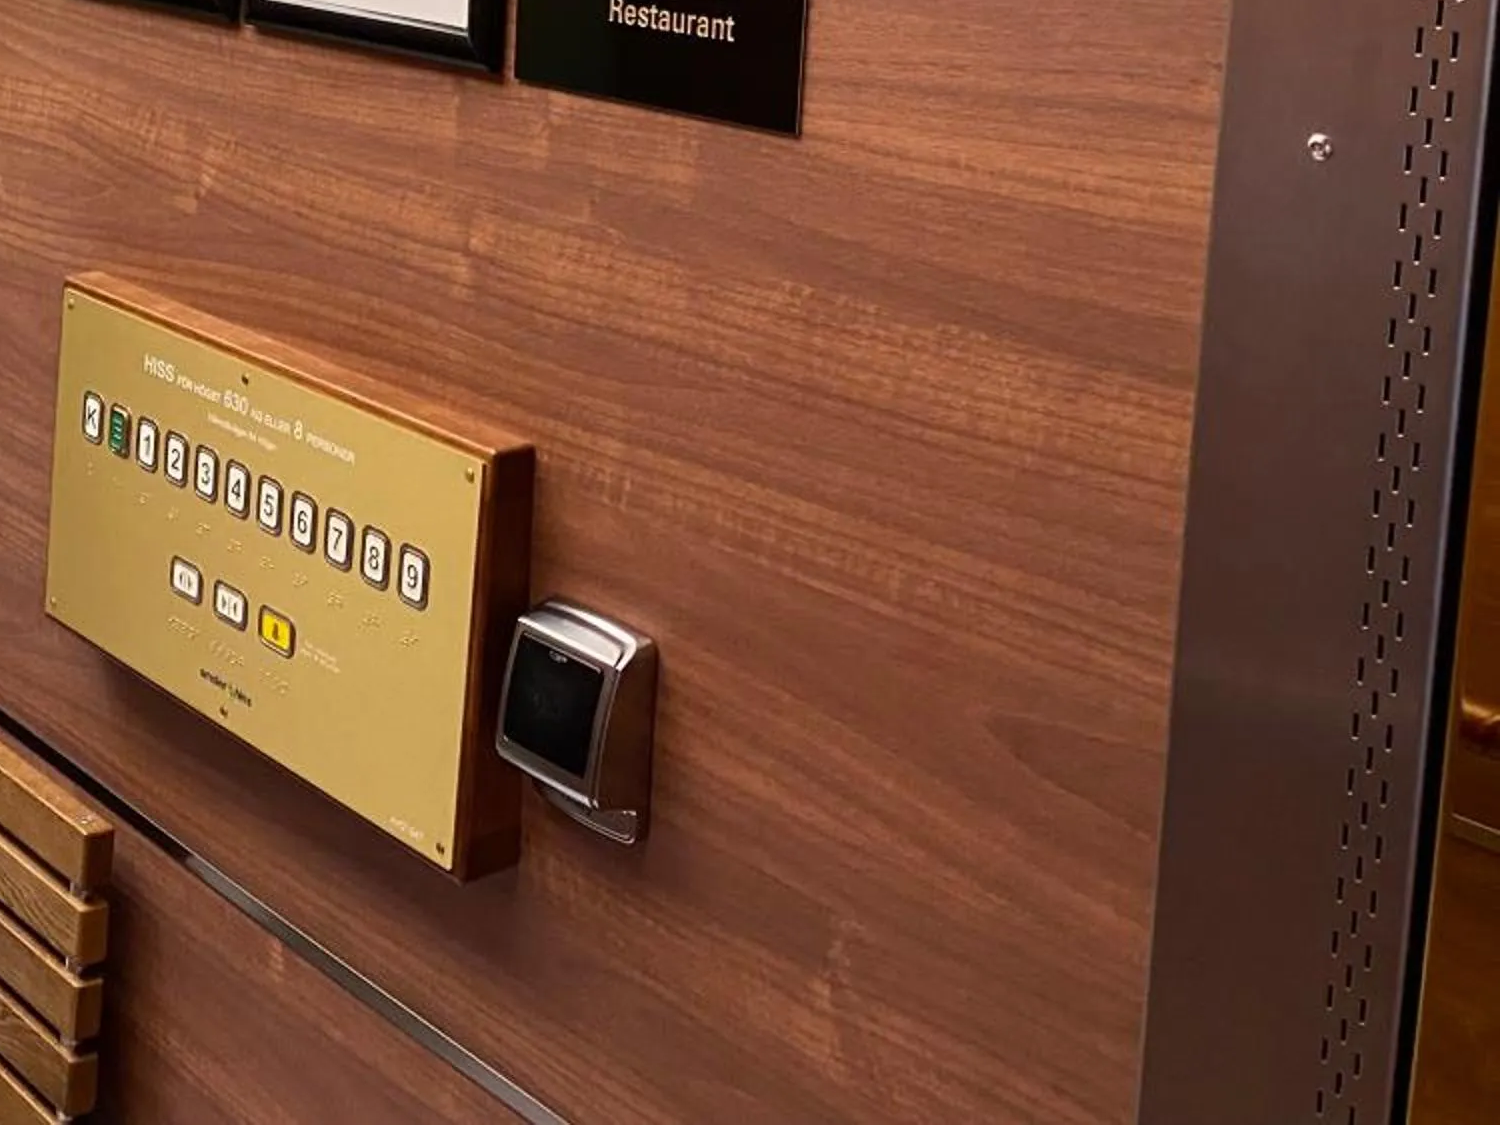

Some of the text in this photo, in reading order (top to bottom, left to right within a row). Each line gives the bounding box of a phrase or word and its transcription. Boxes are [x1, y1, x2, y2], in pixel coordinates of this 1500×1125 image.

[143, 353, 176, 384] HISS
[223, 390, 249, 415] 630
[293, 420, 303, 440] 8
[86, 405, 97, 430] K
[144, 434, 151, 457] 1
[171, 448, 181, 471] 2
[201, 463, 211, 486] 3
[231, 478, 242, 502] 4
[263, 494, 274, 518] 5
[297, 511, 308, 535] 6
[332, 527, 343, 552] 7
[368, 546, 380, 570] 8
[407, 564, 419, 589] 9
